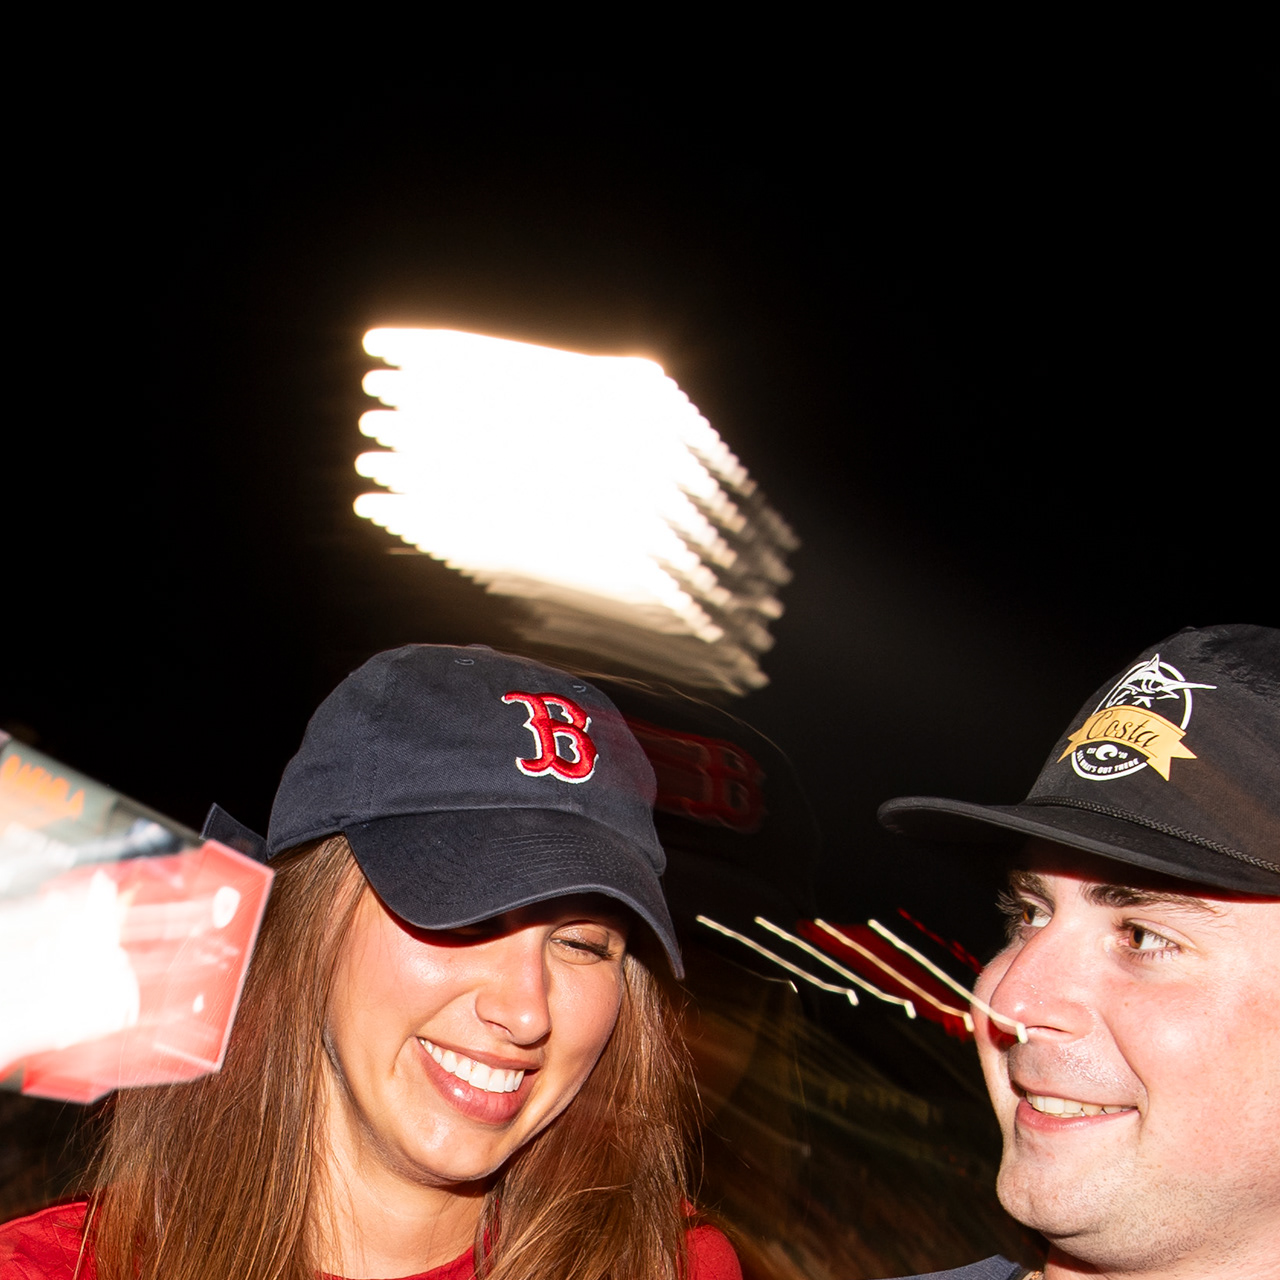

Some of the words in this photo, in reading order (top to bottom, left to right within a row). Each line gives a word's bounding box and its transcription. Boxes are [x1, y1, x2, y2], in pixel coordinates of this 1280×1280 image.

[501, 691, 600, 784] B
[1086, 710, 1160, 749] Costa
[1097, 766, 1113, 774] OUT
